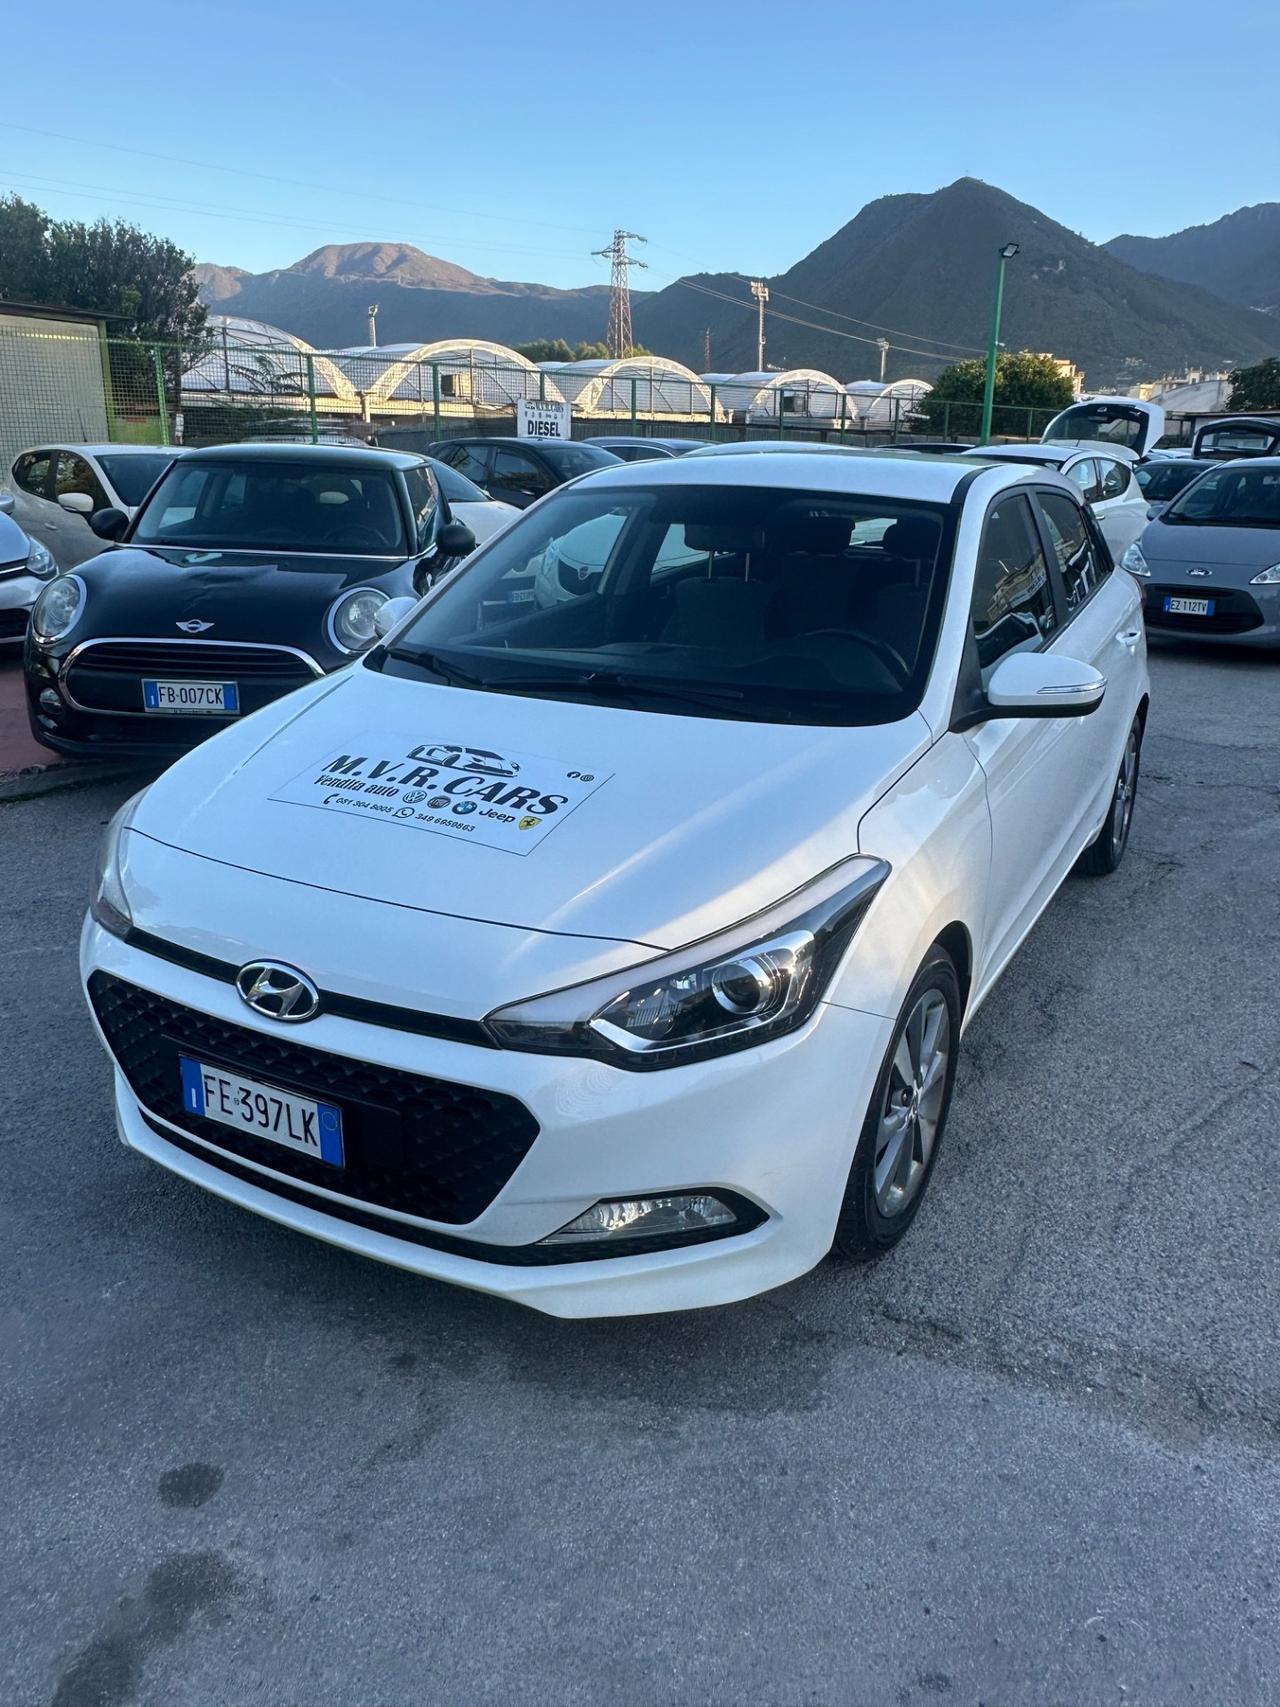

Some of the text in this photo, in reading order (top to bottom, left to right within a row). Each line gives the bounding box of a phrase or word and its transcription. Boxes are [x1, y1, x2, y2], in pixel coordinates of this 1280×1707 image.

[527, 420, 561, 437] DIESEL
[314, 774, 400, 797] Vendita auto
[478, 808, 517, 824] Jeep
